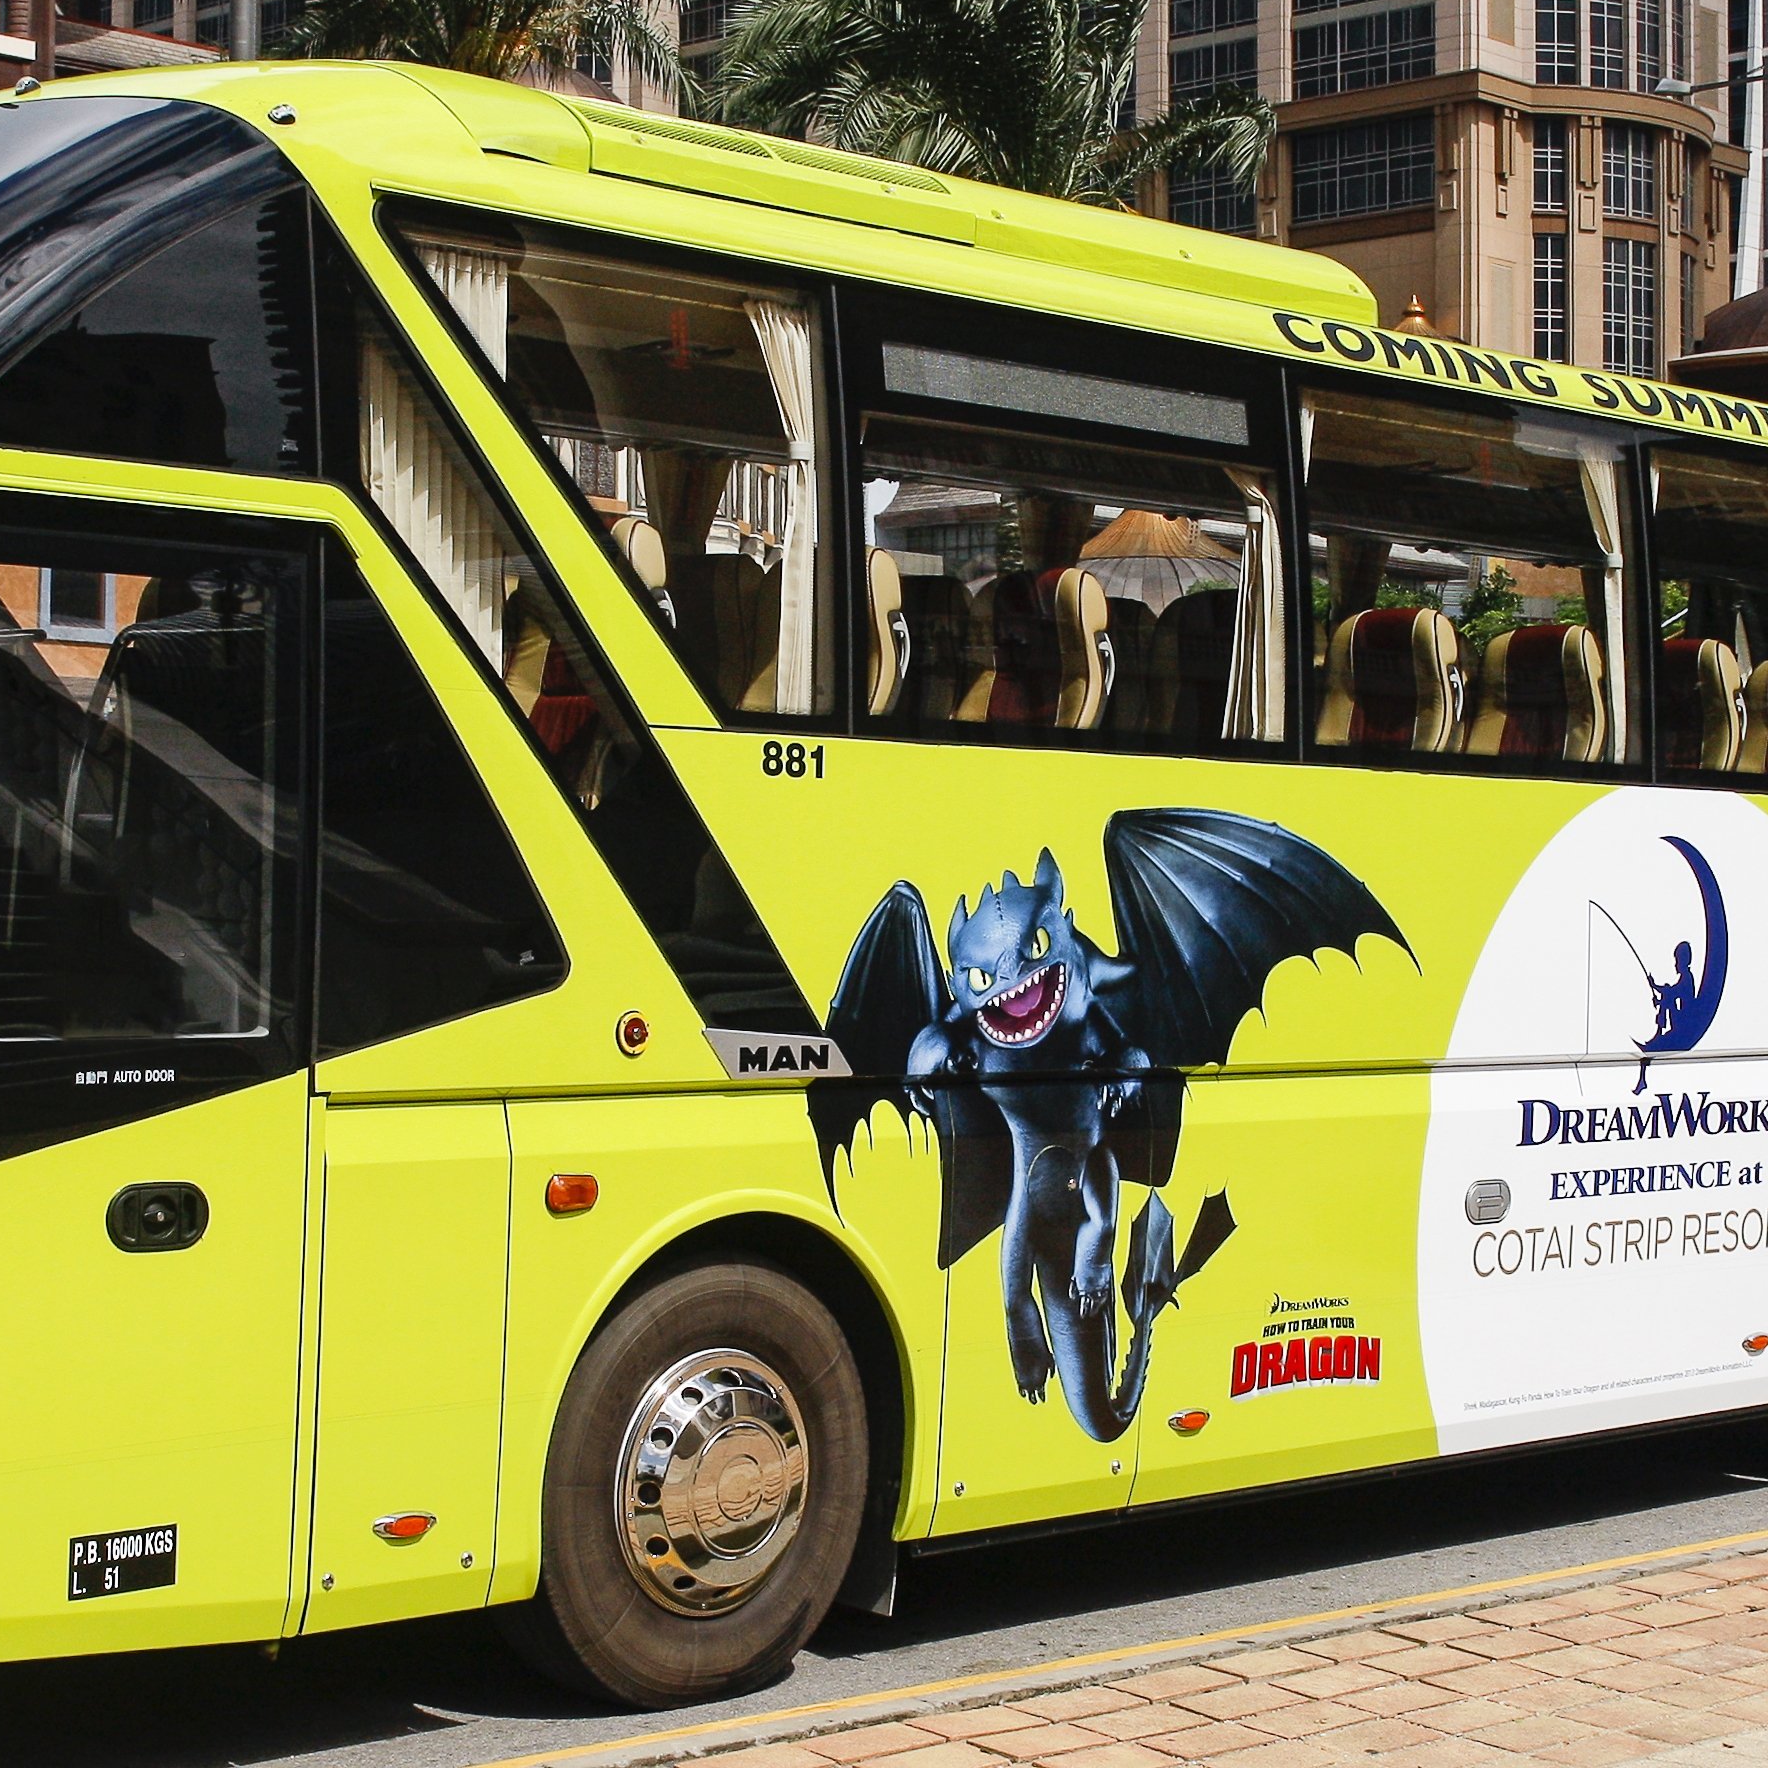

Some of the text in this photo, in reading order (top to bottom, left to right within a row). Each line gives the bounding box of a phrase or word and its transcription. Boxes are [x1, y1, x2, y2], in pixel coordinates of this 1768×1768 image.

[1272, 312, 1559, 399] COMING
[762, 740, 824, 779] 881
[113, 1070, 141, 1083] AUTO
[144, 1069, 175, 1082] DOOR
[739, 1044, 829, 1073] MAN
[1549, 1161, 1763, 1201] EXPERIENCE at
[1473, 1225, 1574, 1278] COTAI
[1584, 1217, 1673, 1266] STRIP
[1262, 1317, 1355, 1337] HOW TO TRAIN YOUR
[1230, 1335, 1381, 1400] DRAGON
[73, 1529, 174, 1566] P.B. 16000 KGS
[73, 1566, 120, 1595] L. 51
